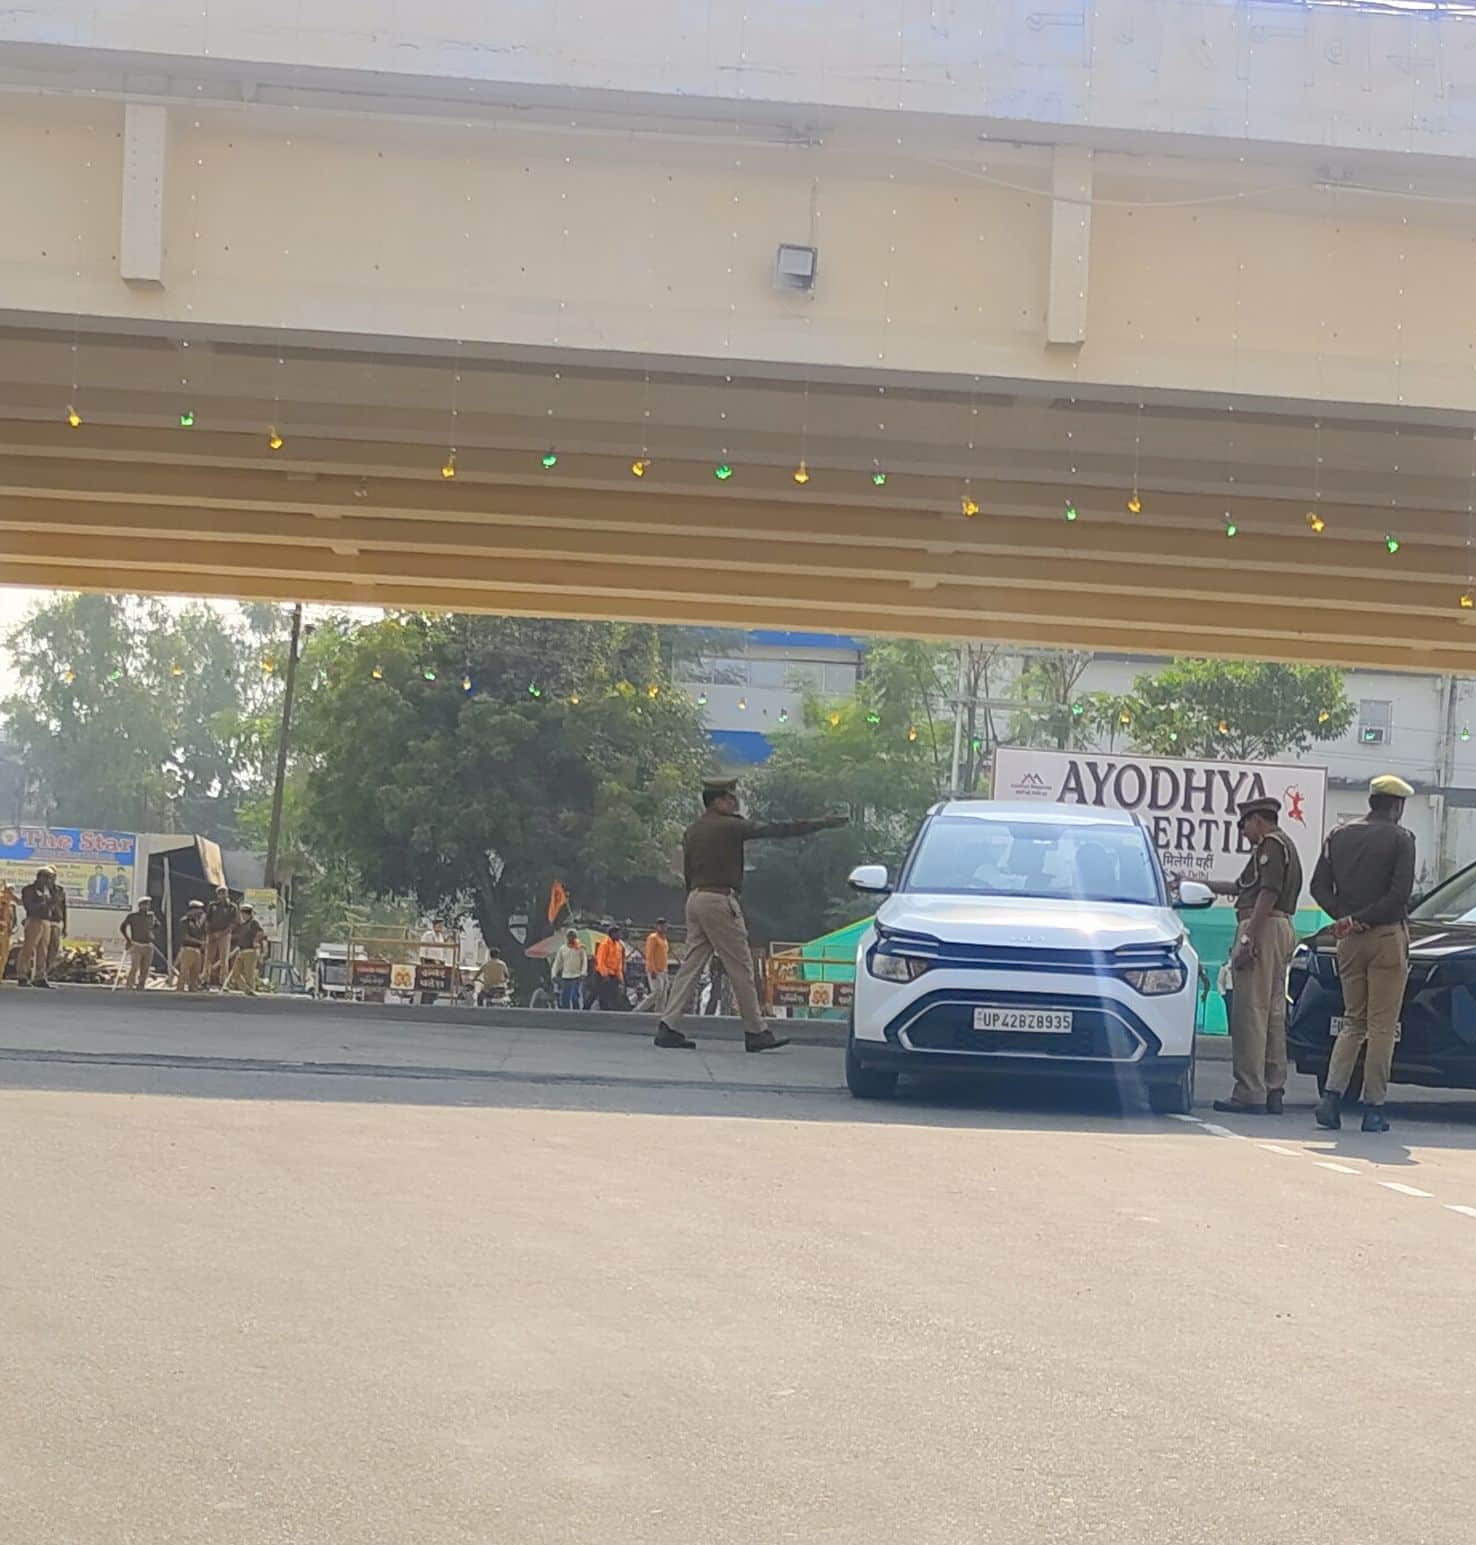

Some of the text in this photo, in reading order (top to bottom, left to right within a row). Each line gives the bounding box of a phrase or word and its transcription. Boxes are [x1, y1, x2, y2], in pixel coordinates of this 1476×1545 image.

[1056, 760, 1268, 816] AYODHYA
[24, 829, 133, 852] The Star
